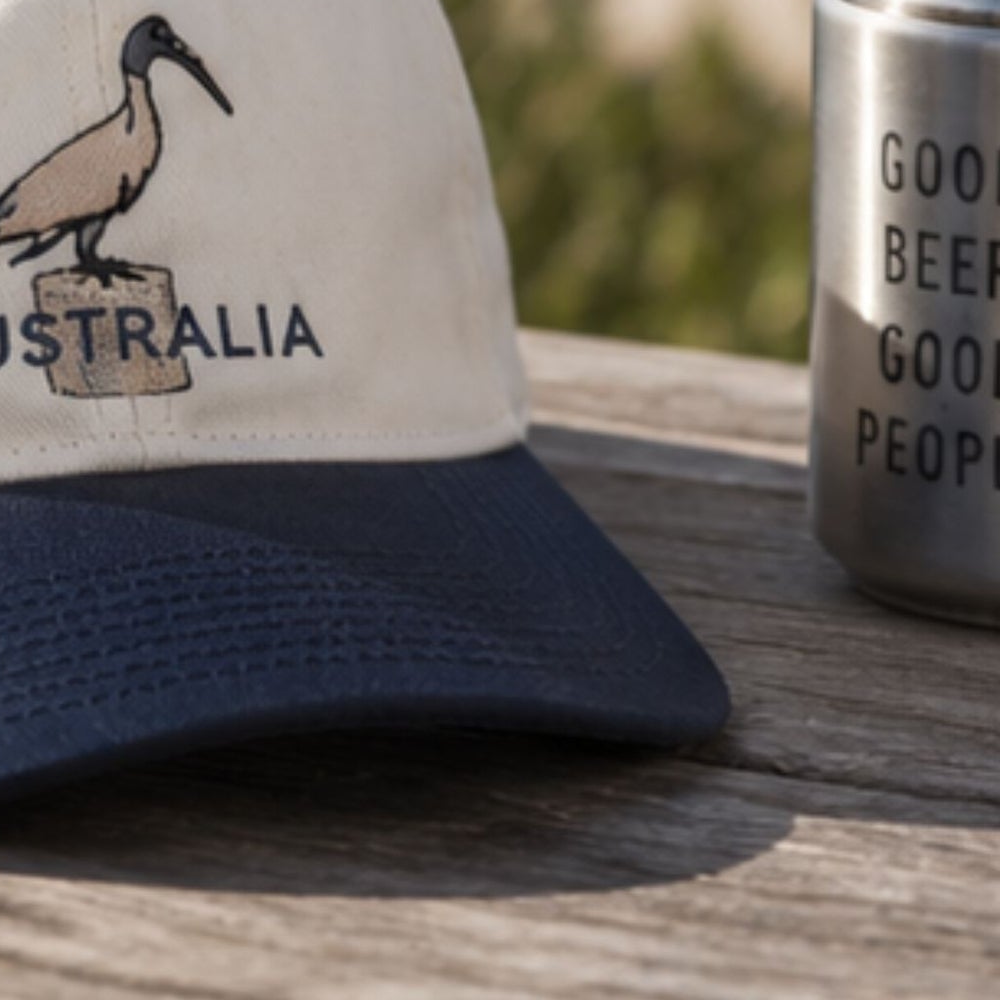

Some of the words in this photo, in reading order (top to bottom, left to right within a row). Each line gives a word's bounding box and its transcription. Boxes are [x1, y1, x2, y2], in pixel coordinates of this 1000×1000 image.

[881, 130, 1000, 206] GOO
[879, 324, 1000, 400] GOO
[856, 408, 1000, 491] PEOP
